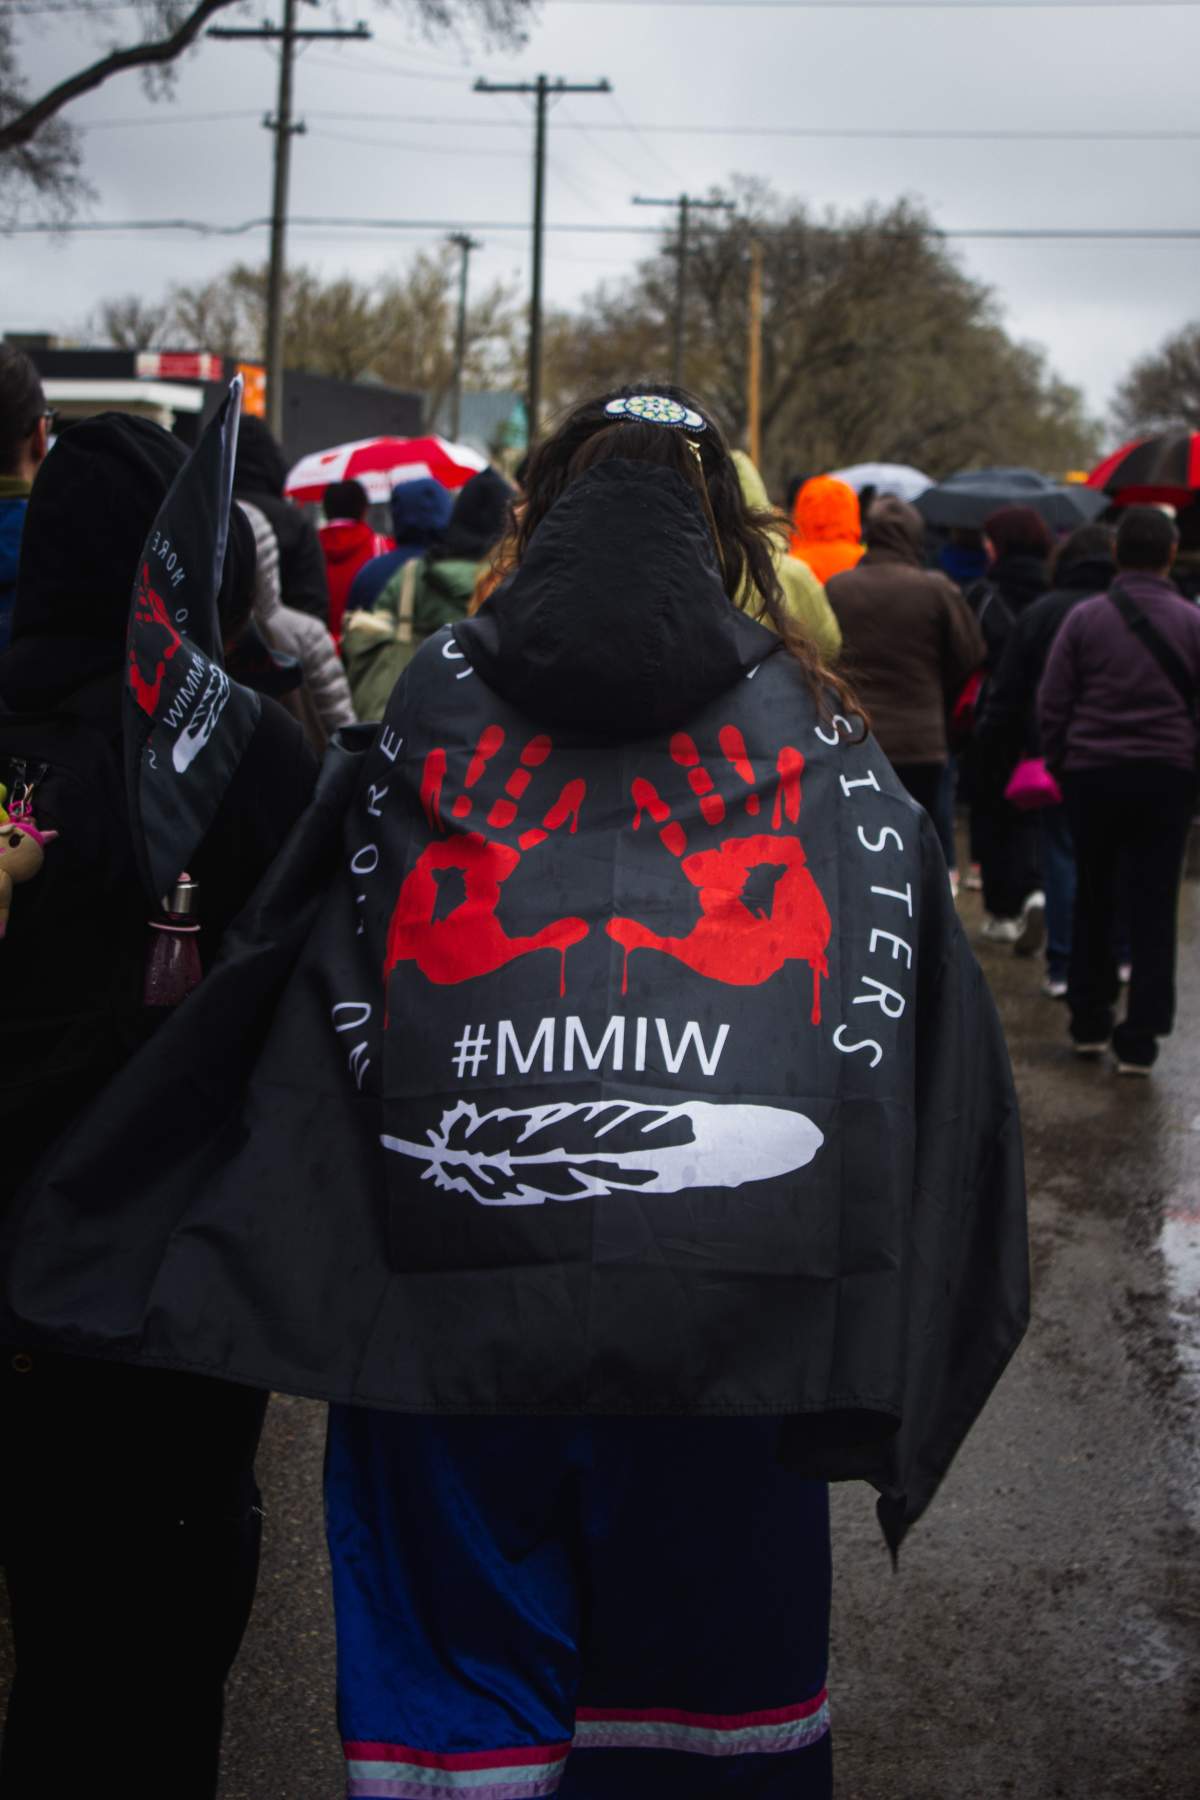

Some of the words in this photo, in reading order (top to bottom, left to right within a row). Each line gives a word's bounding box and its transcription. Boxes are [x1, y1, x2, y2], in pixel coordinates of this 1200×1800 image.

[351, 725, 403, 934] ORE
[814, 714, 913, 1068] SISTERS
[452, 1015, 730, 1077] #MMIW
